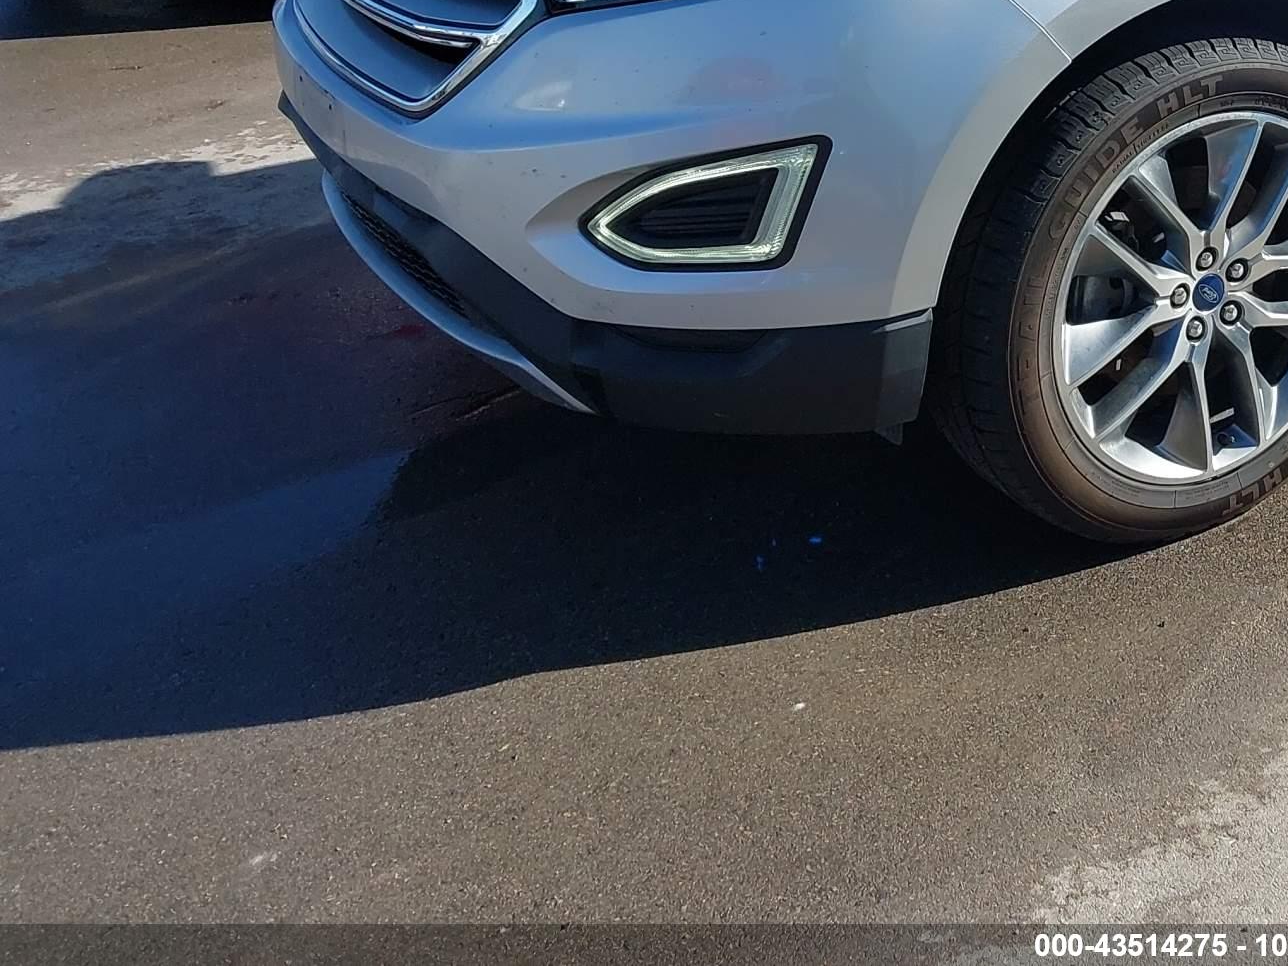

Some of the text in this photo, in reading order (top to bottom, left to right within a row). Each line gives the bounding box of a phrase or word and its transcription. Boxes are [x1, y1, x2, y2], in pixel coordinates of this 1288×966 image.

[1048, 115, 1146, 240] GUIDE
[1156, 74, 1224, 120] HLT
[1222, 467, 1283, 519] HLT
